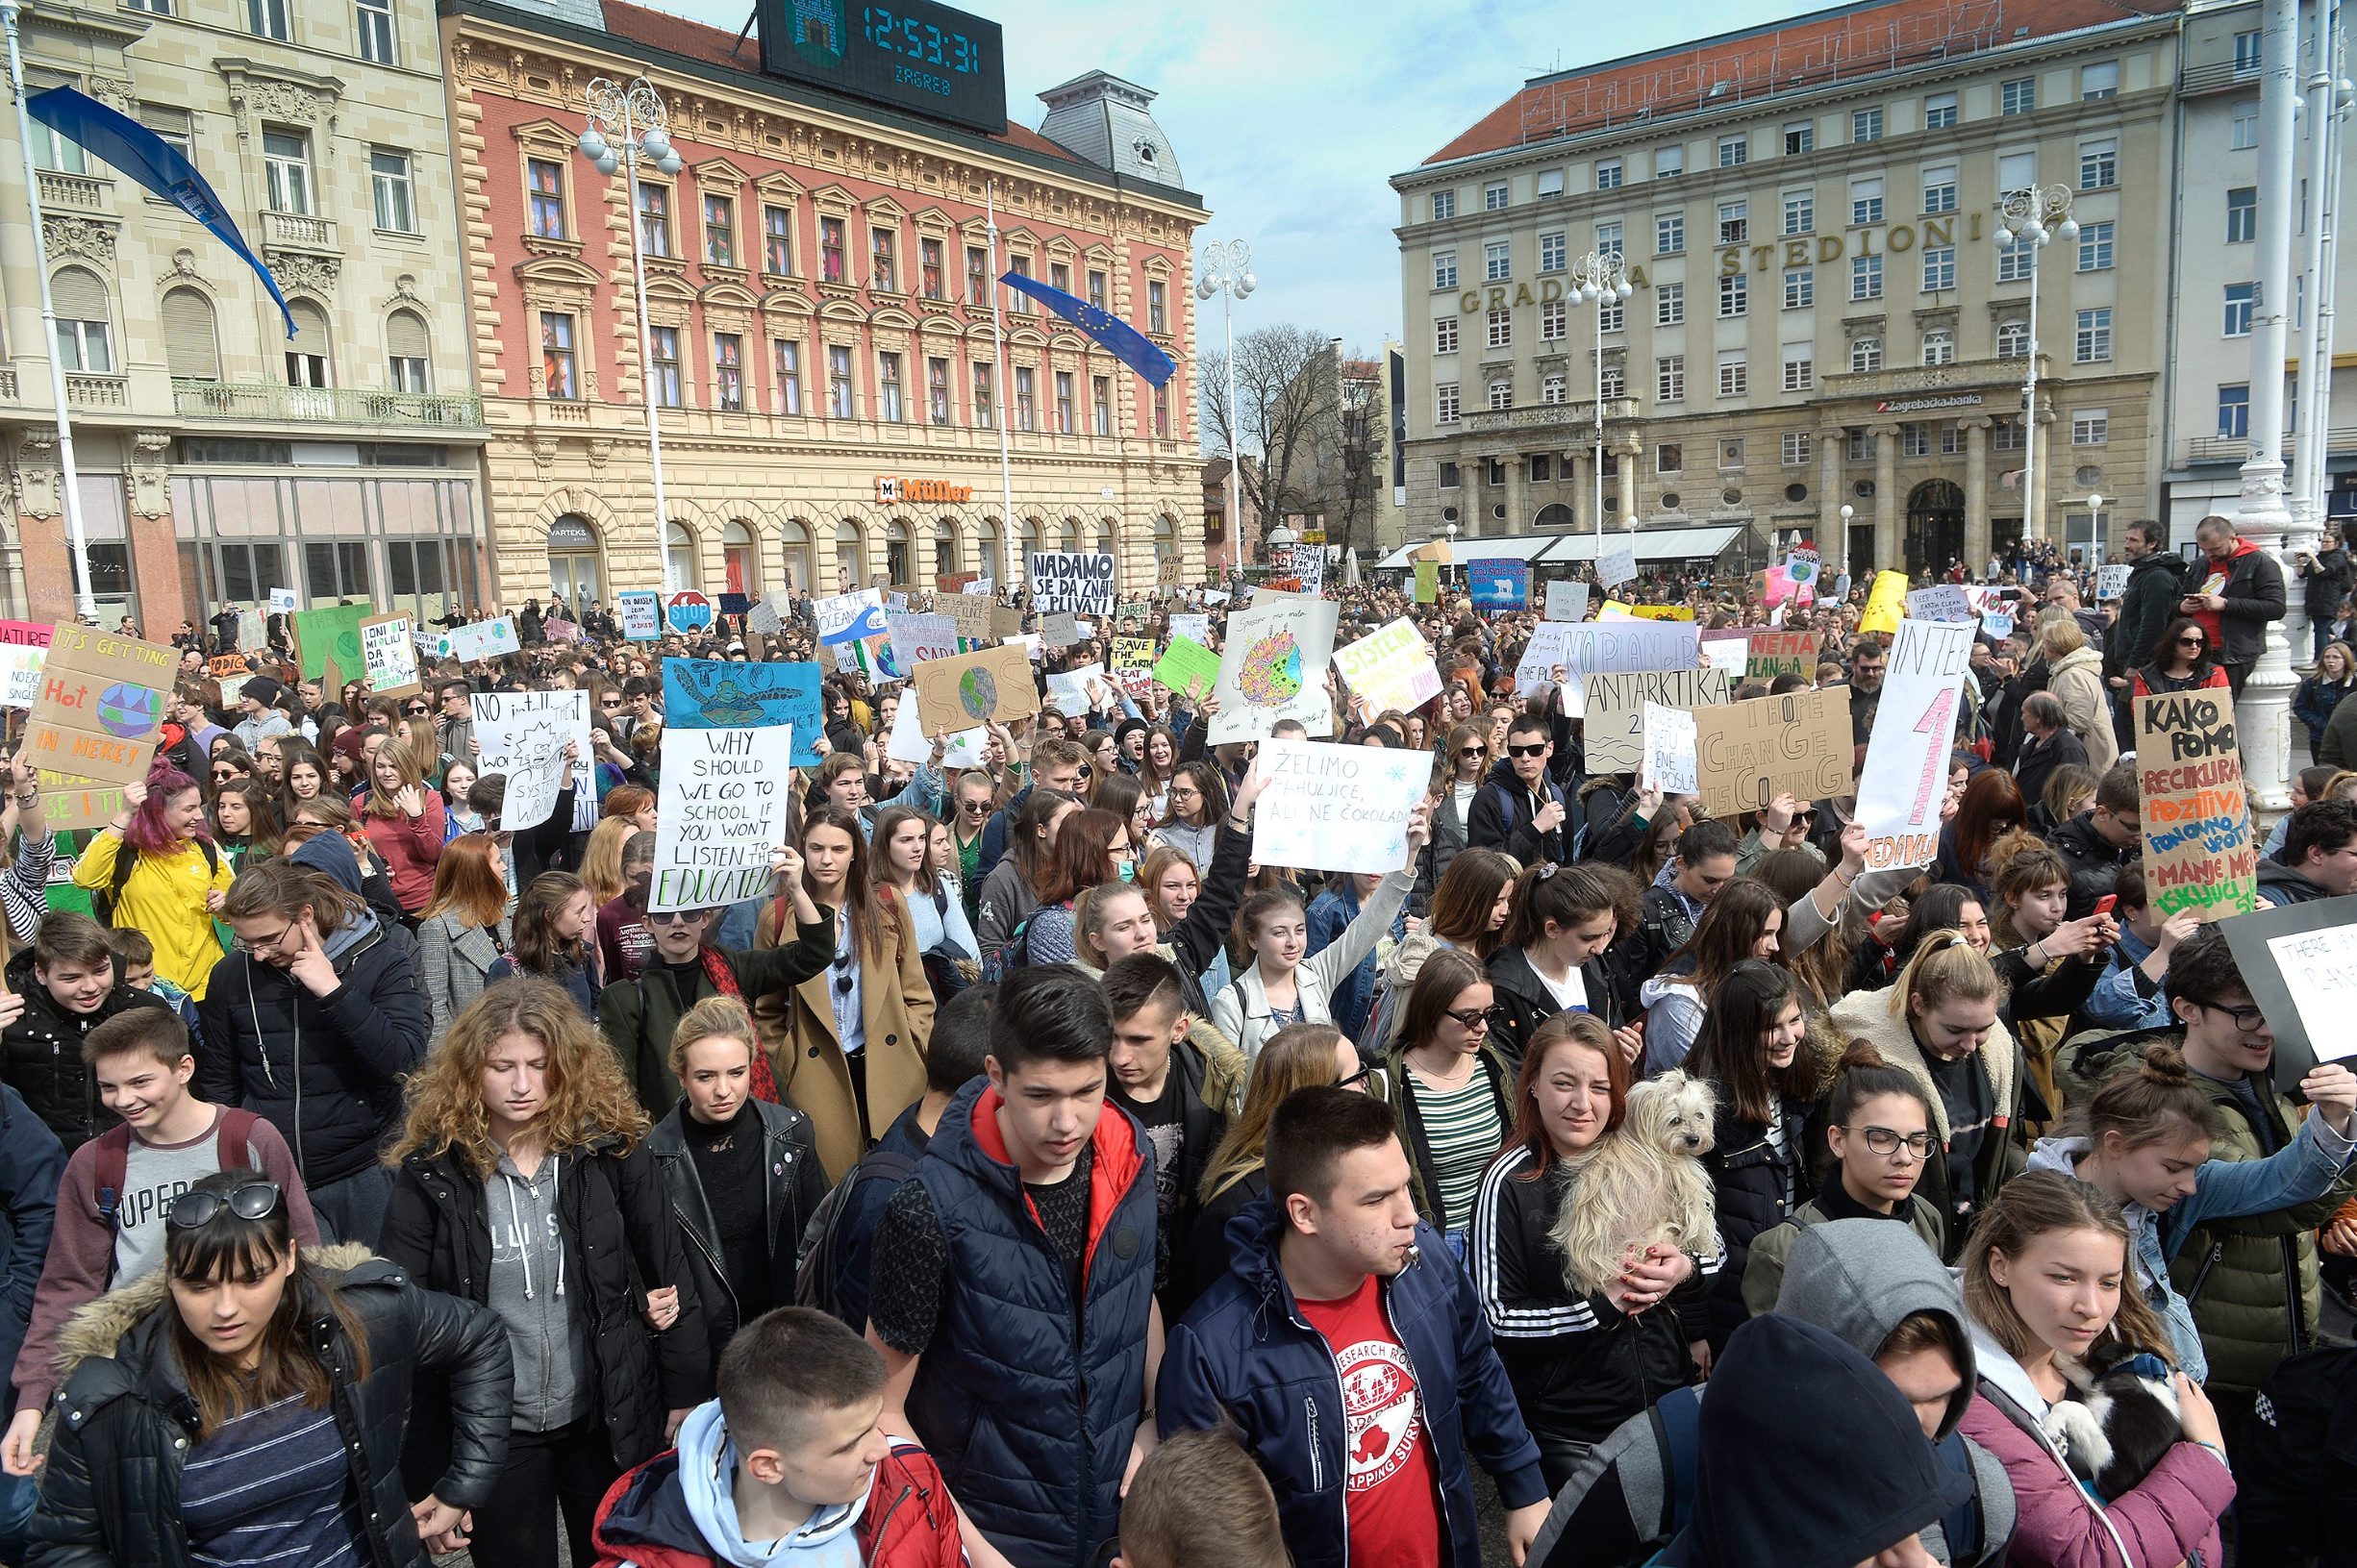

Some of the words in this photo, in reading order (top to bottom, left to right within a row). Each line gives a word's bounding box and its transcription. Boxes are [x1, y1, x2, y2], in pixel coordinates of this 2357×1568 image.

[864, 7, 979, 76] 12:53:31
[894, 64, 951, 96] ZAGREB
[1460, 264, 1650, 313] GRADA
[1887, 397, 1947, 413] Zagrebačka
[1949, 394, 1982, 407] banka
[901, 478, 973, 502] Müller
[1161, 556, 1184, 565] VRIJEME
[1294, 544, 1316, 555] WHAT
[1294, 553, 1320, 562] STAND
[1034, 554, 1113, 580] NADAMO
[1158, 570, 1178, 583] SAD!
[1292, 567, 1314, 577] WHAT
[1034, 579, 1054, 596] SE
[1059, 579, 1078, 597] DA
[1081, 579, 1114, 599] ZNATE
[1915, 594, 1931, 604] KEEP
[1935, 590, 1951, 600] THE
[671, 604, 709, 621] STOP
[816, 595, 844, 615] LIKE
[845, 591, 866, 607] THE
[1050, 596, 1108, 614] PLIVATI
[1118, 603, 1148, 617] IZABERI
[1920, 602, 1940, 610] EARTH
[1931, 608, 1944, 617] NOT
[1976, 590, 2015, 616] NOW
[454, 624, 485, 638] FRIDAYS
[818, 609, 858, 631] OCEANS
[53, 626, 89, 651] IT'S
[95, 637, 171, 668] GETTING
[476, 635, 485, 645] 4
[1116, 638, 1149, 651] SAVE
[1750, 633, 1816, 655] NEMA
[366, 648, 383, 660] DA
[367, 659, 385, 670] IMA
[1112, 650, 1135, 660] THE
[1123, 659, 1154, 669] EARTH
[1560, 630, 1595, 684] NO
[44, 678, 88, 709] Hot
[1585, 668, 1730, 715] ANTARKTIKA
[474, 694, 501, 722] NO
[1746, 703, 1758, 729] I
[1767, 692, 1824, 725] HOPE
[2144, 697, 2219, 734] KAKO
[35, 728, 60, 752] IN
[72, 734, 139, 768] HERE!
[706, 731, 754, 757] WHY
[693, 758, 764, 777] SHOULD
[1274, 746, 1359, 779] ŽELIMO
[1912, 687, 1956, 826] 1
[679, 783, 713, 801] WE
[718, 782, 745, 800] GO
[754, 780, 774, 798] TO
[1272, 775, 1365, 802] PAHULJICE,
[1707, 784, 1731, 816] IS
[1734, 754, 1843, 811] COMING
[682, 804, 750, 822] SCHOOL
[760, 802, 772, 818] IF
[1270, 801, 1297, 822] ALI
[1309, 804, 1333, 822] NE
[2148, 789, 2244, 824] POZITIVA
[679, 824, 712, 842] YOU
[721, 817, 771, 837] WON'T
[2148, 815, 2234, 856] PONOVNO
[674, 845, 745, 866] LISTEN
[752, 841, 769, 853] TO
[748, 851, 775, 865] THE
[2157, 857, 2224, 887] MANJE
[657, 864, 773, 908] EDUCATED
[2281, 935, 2331, 962] THERE
